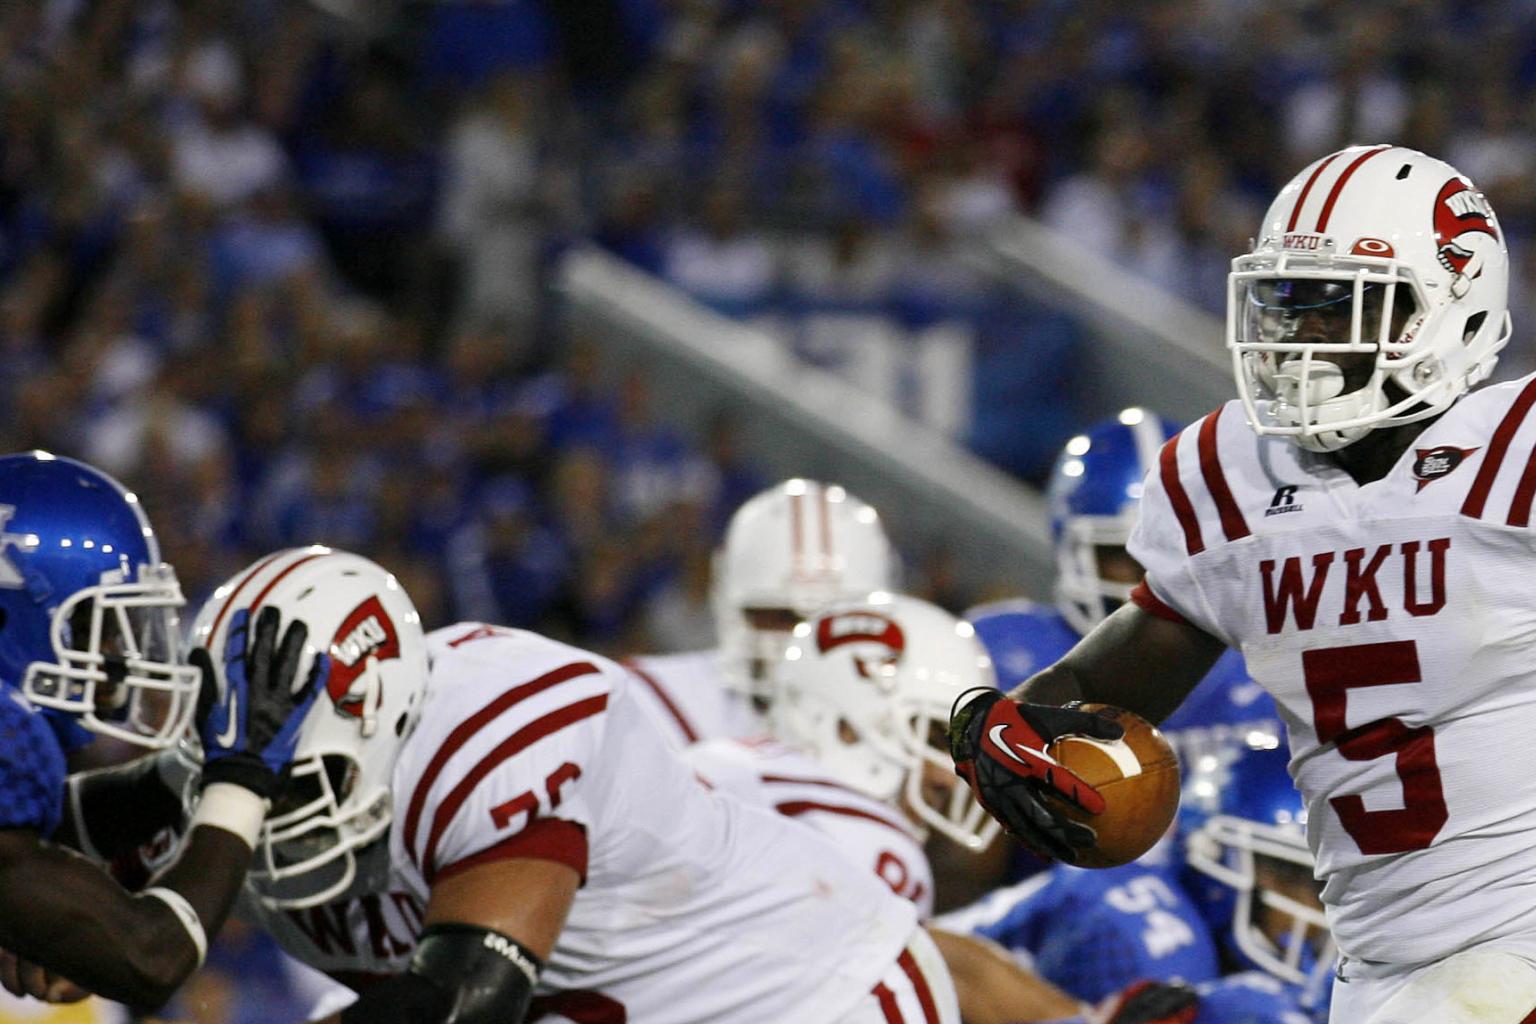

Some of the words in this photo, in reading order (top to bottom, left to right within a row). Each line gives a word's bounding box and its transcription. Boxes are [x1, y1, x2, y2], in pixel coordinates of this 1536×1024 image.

[1283, 235, 1320, 250] WKU
[1259, 538, 1451, 634] WKU
[333, 615, 386, 667] WKU
[1302, 640, 1449, 855] 5
[1105, 874, 1197, 957] 54
